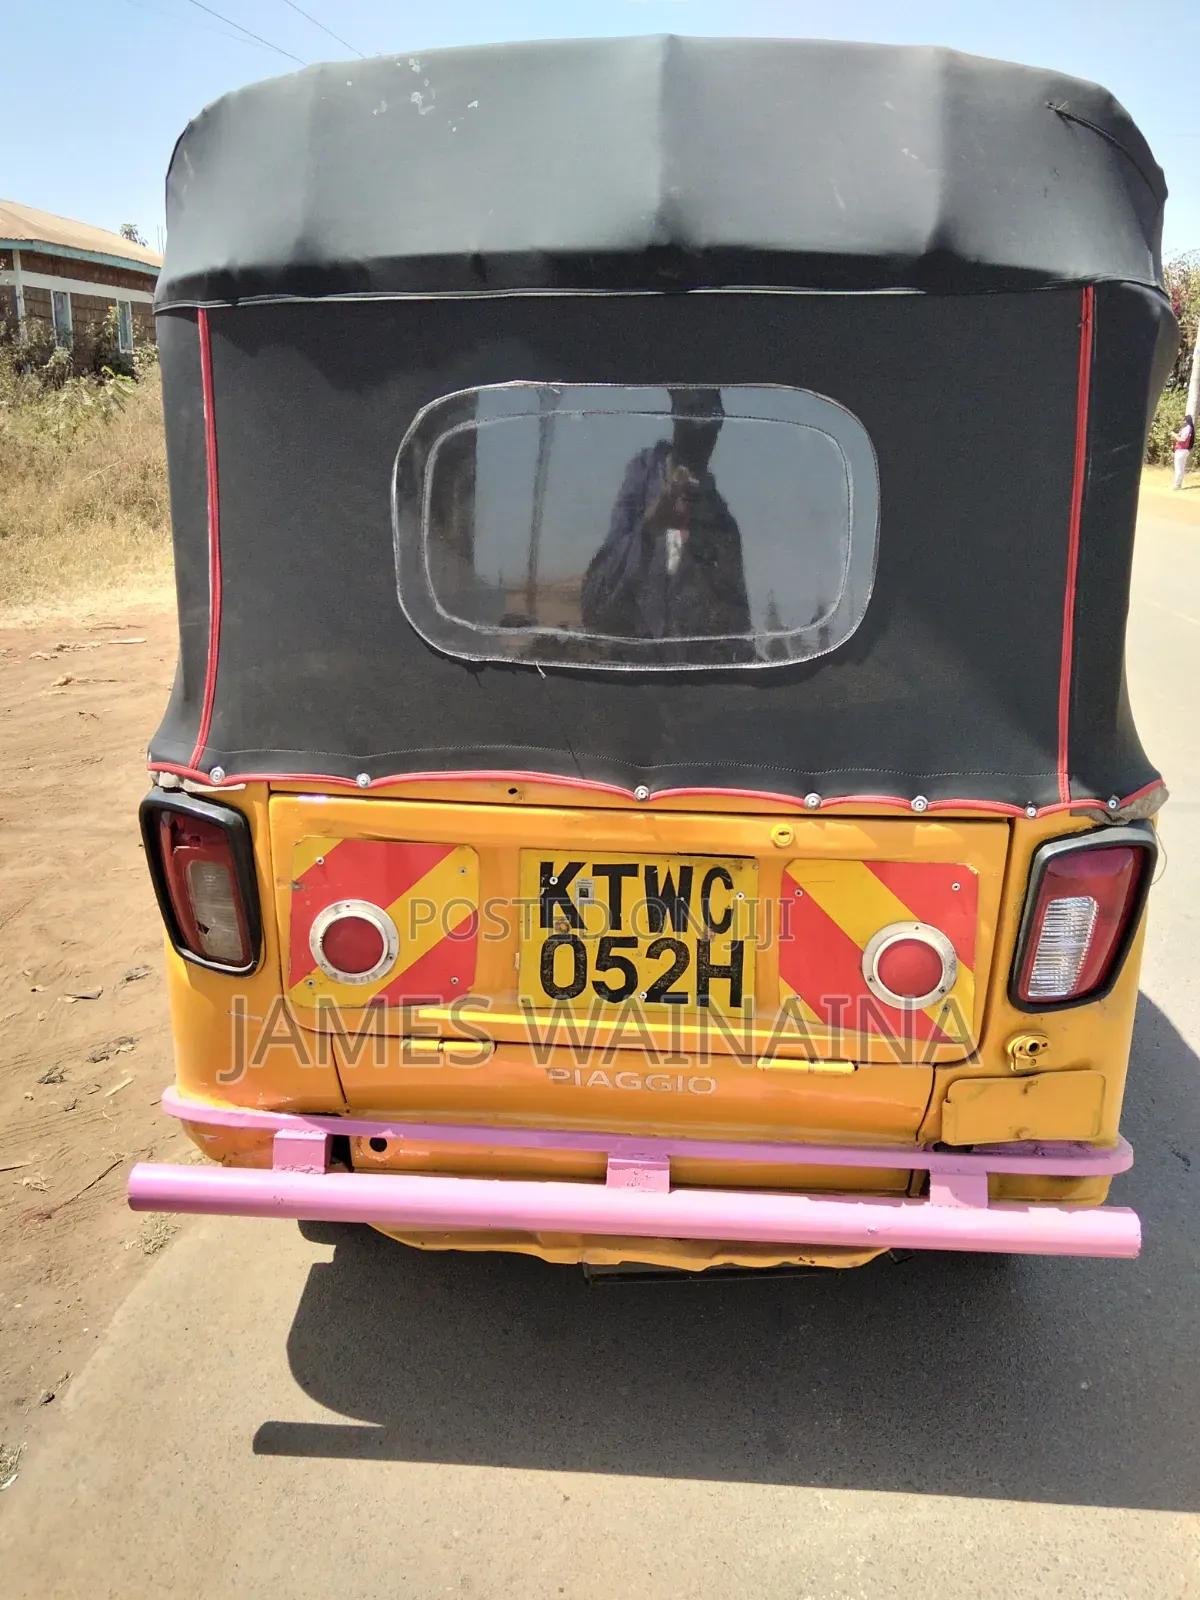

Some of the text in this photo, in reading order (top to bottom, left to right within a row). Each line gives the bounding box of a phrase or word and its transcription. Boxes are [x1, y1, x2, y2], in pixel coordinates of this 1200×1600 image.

[540, 861, 735, 934] KTWC
[540, 934, 745, 1008] 052H
[546, 1068, 717, 1095] PIAGGIO
